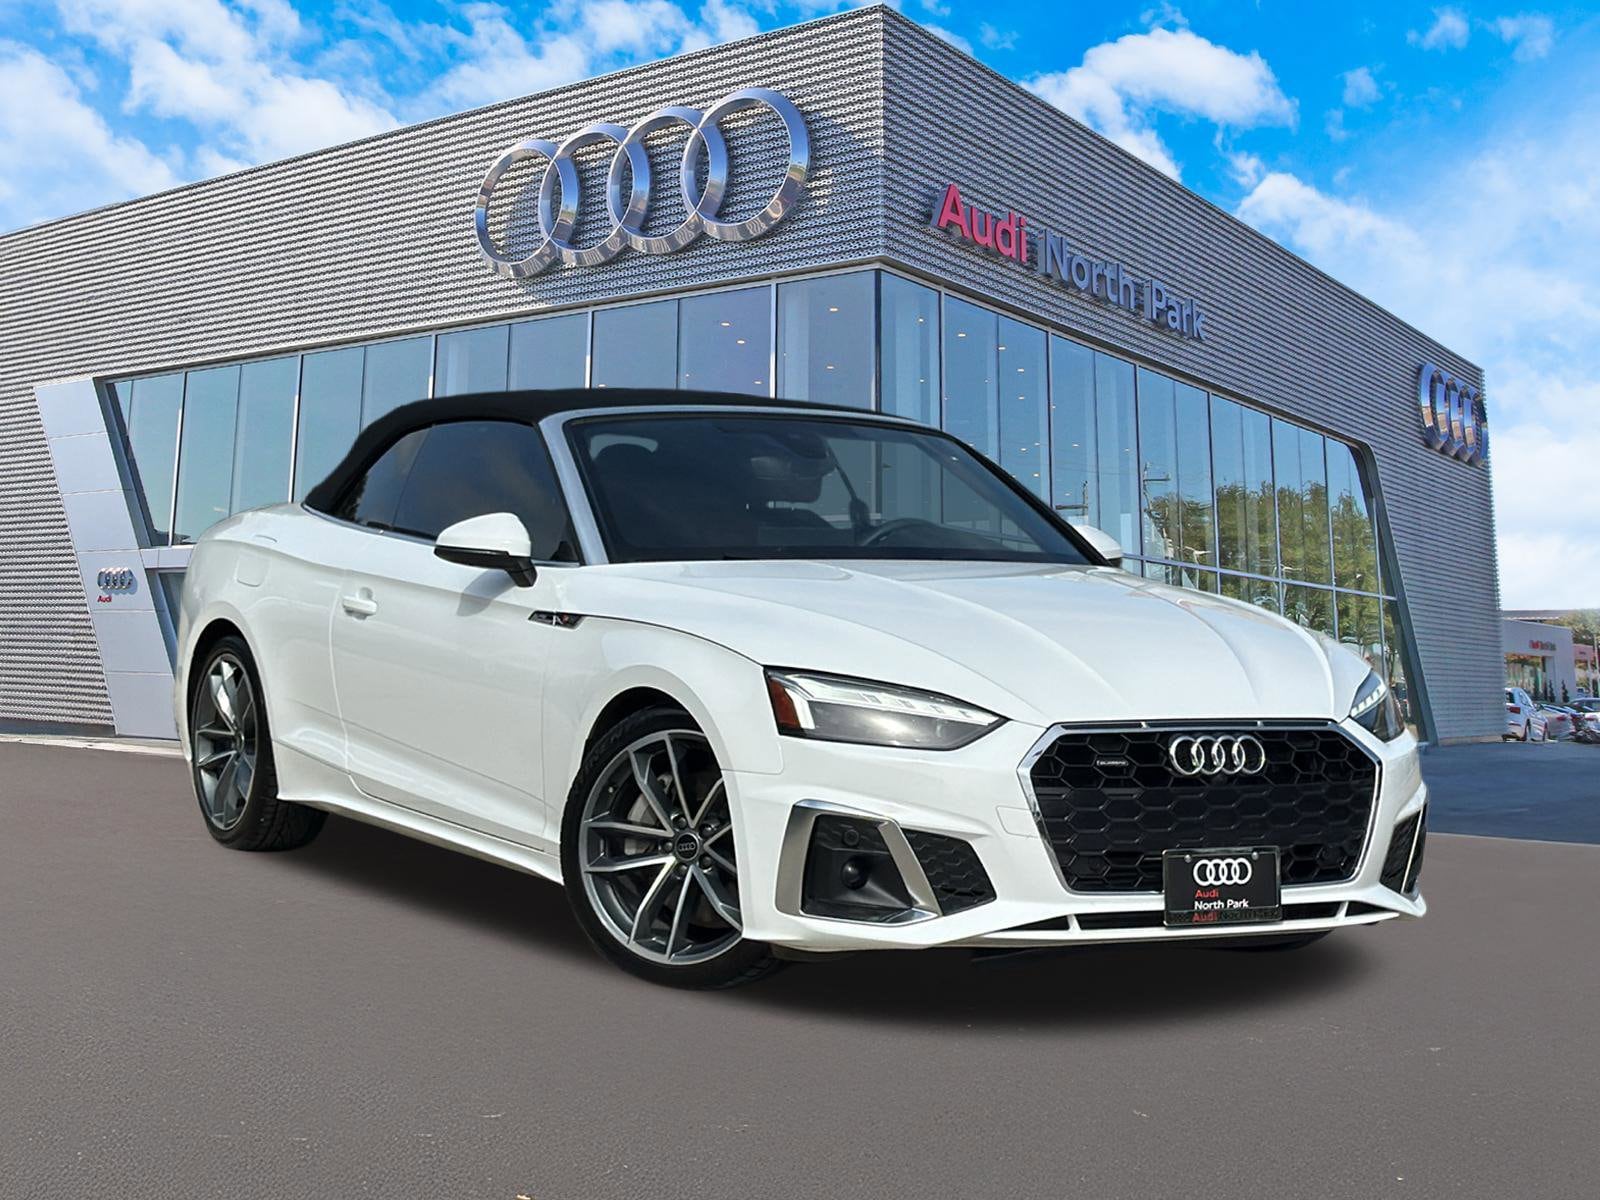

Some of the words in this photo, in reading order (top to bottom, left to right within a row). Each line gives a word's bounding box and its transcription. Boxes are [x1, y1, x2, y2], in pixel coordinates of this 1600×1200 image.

[934, 183, 1028, 264] Audi
[1038, 229, 1136, 310] North
[1143, 278, 1206, 341] Park
[1195, 889, 1219, 898] Audi
[1194, 900, 1225, 910] North
[1226, 899, 1249, 909] Park
[1192, 912, 1217, 922] Audi
